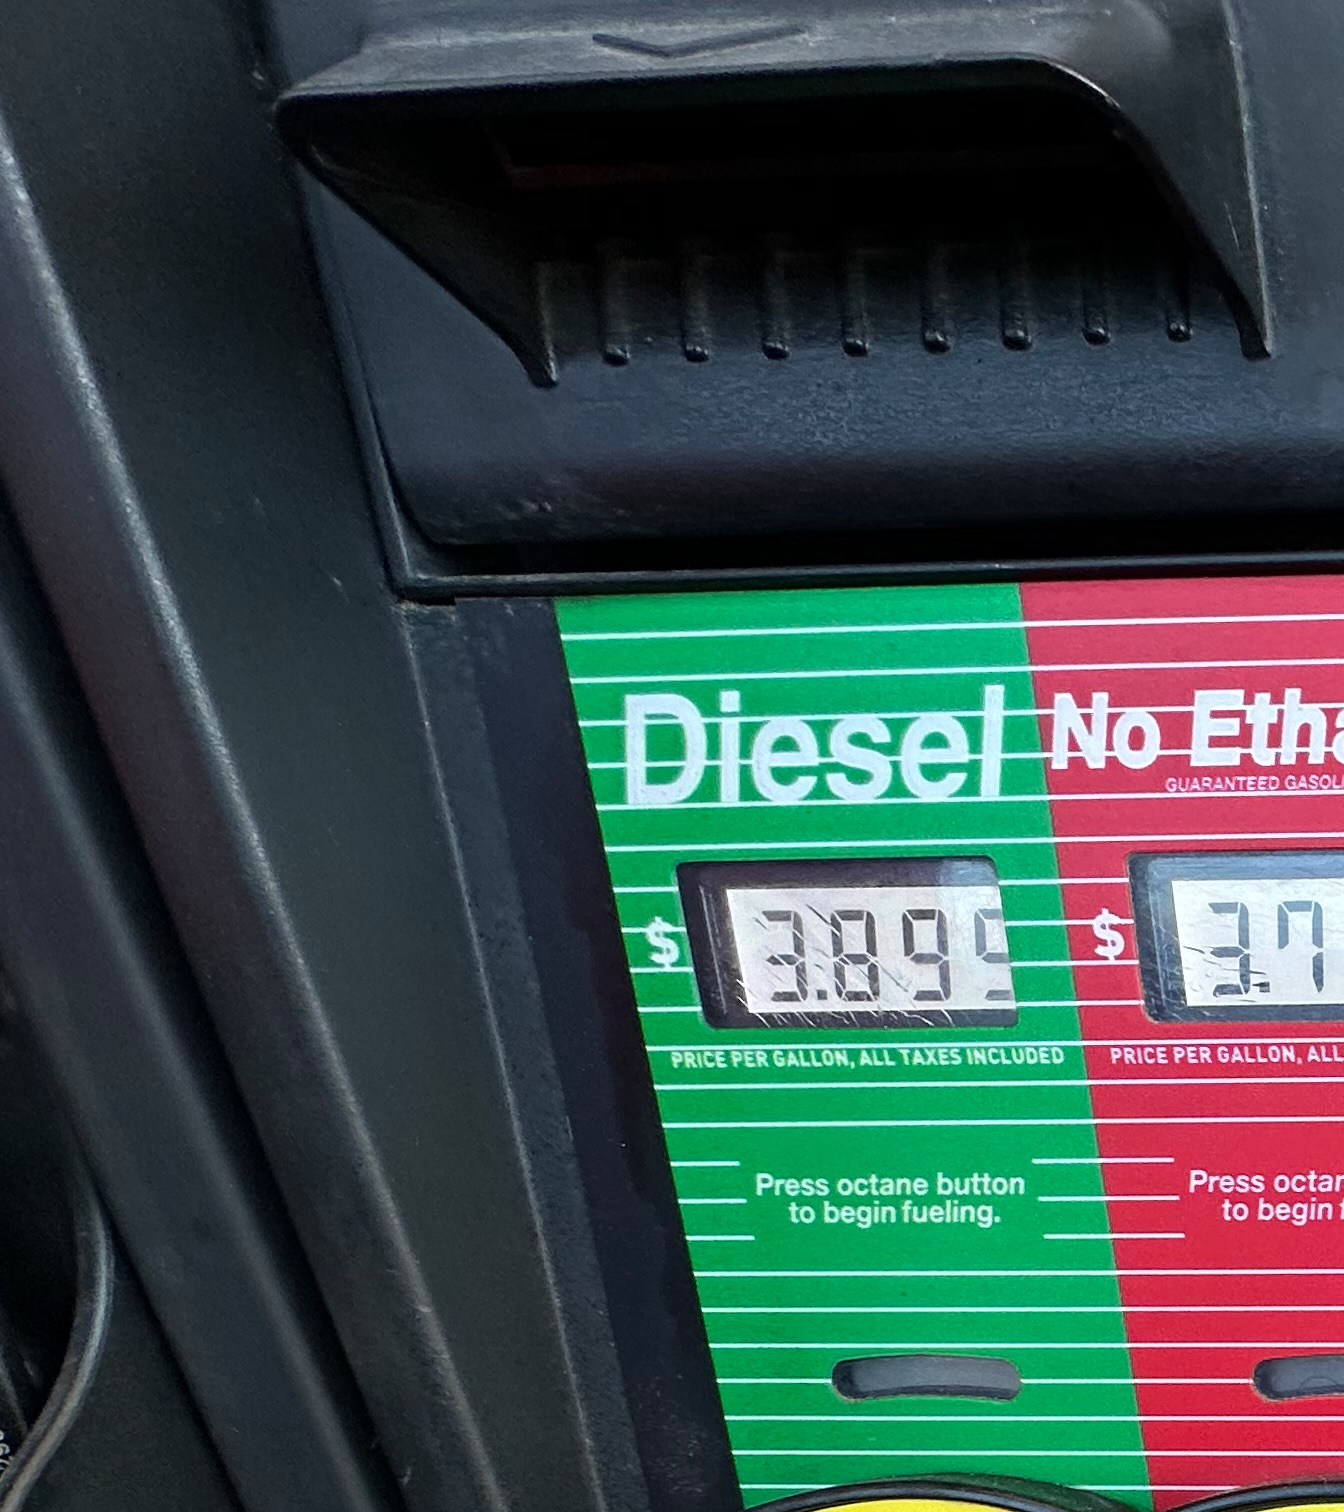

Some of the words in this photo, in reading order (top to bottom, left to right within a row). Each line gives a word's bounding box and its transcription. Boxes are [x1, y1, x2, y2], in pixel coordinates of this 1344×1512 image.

[622, 684, 1005, 806] Diesel
[1051, 692, 1161, 770] No
[1165, 775, 1279, 793] GUARANTEED
[647, 916, 679, 968] $
[1092, 908, 1125, 961] $
[671, 1050, 729, 1069] PRICE
[732, 1049, 770, 1067] PER
[774, 1048, 855, 1069] GALLON,
[860, 1048, 900, 1067] ALL
[902, 1048, 963, 1066] TAXES
[967, 1046, 1065, 1065] INCLUDED
[1110, 1046, 1169, 1065] PRICE
[1173, 1046, 1212, 1064] PER
[1217, 1045, 1302, 1066] GALLON,
[1307, 1044, 1344, 1062] ALL
[755, 1173, 830, 1197] Press
[836, 1173, 928, 1197] octane
[935, 1172, 1025, 1196] button
[1189, 1170, 1265, 1194] Press
[788, 1201, 817, 1223] to
[822, 1200, 896, 1230] begin
[900, 1199, 1002, 1228] fueling.
[1222, 1199, 1250, 1221] to
[1257, 1198, 1334, 1228] begin
